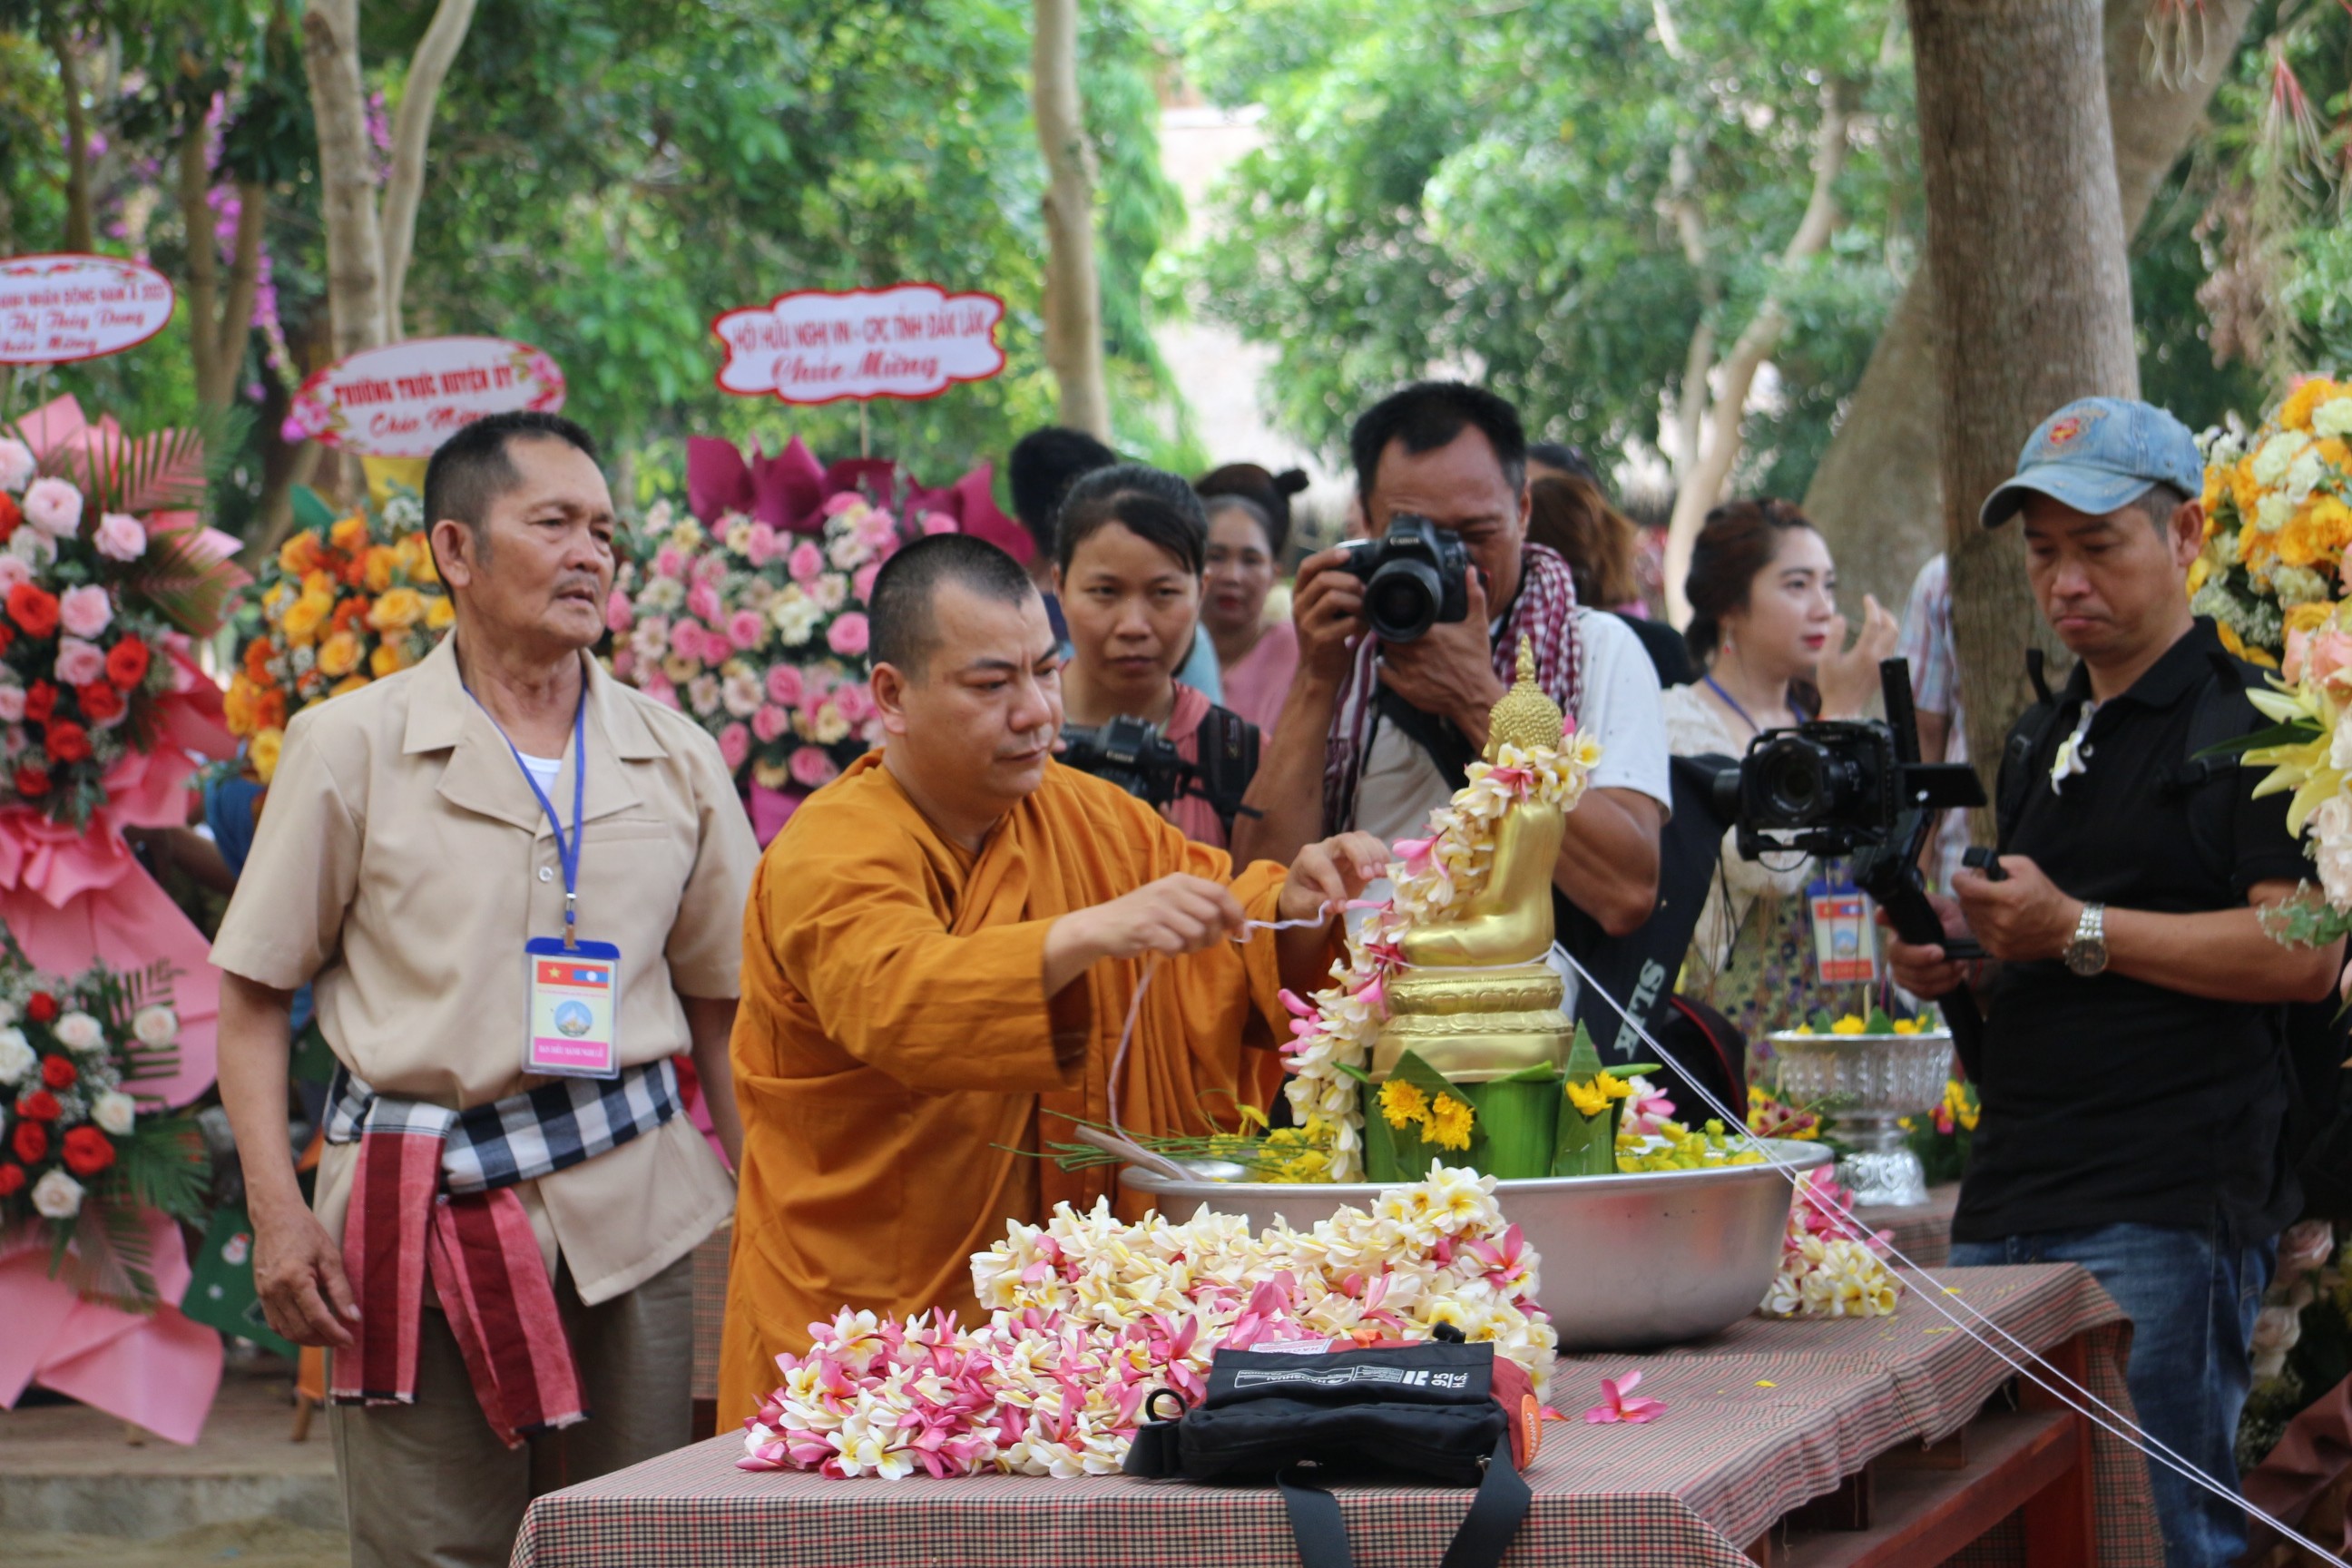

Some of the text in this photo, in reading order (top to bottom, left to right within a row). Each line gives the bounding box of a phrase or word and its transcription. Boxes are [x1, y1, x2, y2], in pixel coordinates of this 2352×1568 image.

[100, 288, 125, 301] NAM
[795, 319, 828, 352] NGHỊ
[47, 335, 98, 355] Mừng
[771, 350, 938, 388] Chúc Mừng
[396, 369, 436, 402] TRỰC
[439, 364, 490, 396] HUYỆN
[370, 411, 420, 437] Chúc
[1389, 535, 1420, 545] Canon
[1106, 750, 1134, 763] Canon
[1266, 1374, 1327, 1384] HAOSHUAI
[1431, 1373, 1449, 1387] 95
